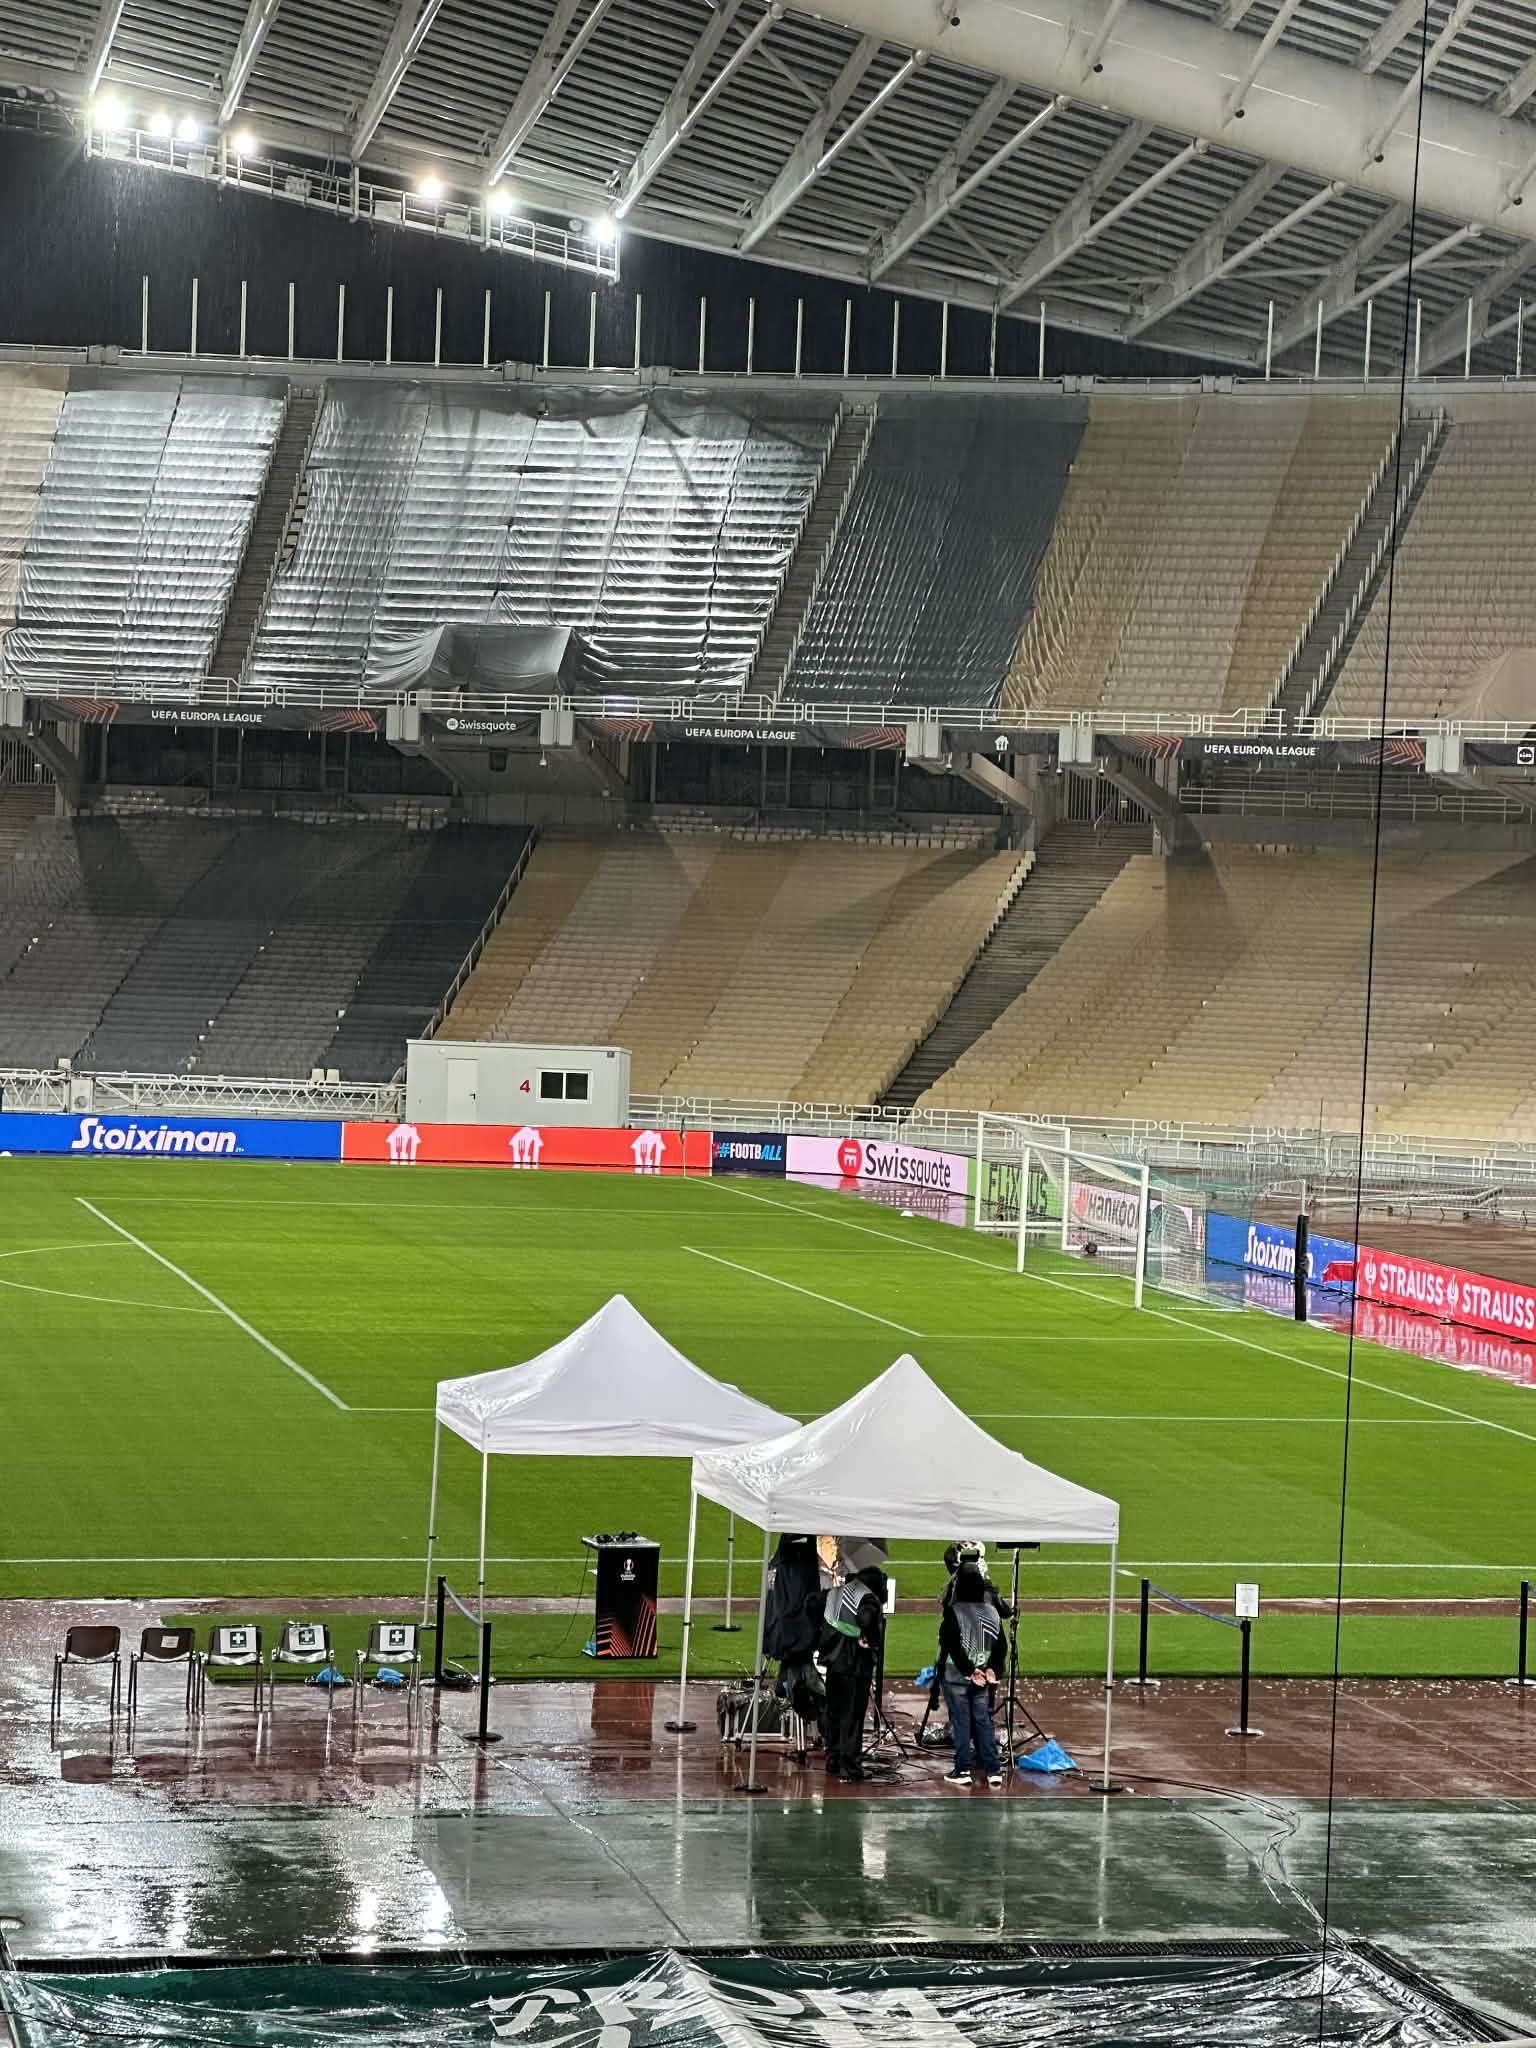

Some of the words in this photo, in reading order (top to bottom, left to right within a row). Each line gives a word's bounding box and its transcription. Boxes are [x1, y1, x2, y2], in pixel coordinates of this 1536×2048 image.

[151, 710, 178, 720] UEFA
[180, 711, 220, 721] EUROPA
[223, 713, 263, 723] LEAGUE
[459, 719, 517, 733] Swissquote
[685, 727, 712, 737] UEFA
[714, 728, 754, 739] EUROPA
[756, 730, 797, 740] LEAGUE
[1204, 744, 1231, 754] UEFA
[1233, 745, 1274, 756] EUROPA
[1276, 746, 1317, 756] LEAGUE
[519, 1079, 531, 1093] 4
[71, 1117, 237, 1153] Stoiximan
[718, 1142, 782, 1161] #FOOTBALL
[864, 1143, 951, 1188] Swissquote
[988, 1162, 1049, 1217] FLIXUS
[1088, 1192, 1141, 1230] Hankoo
[1244, 1225, 1314, 1278] Stoiximn
[1379, 1262, 1445, 1306] STRAUSS
[1461, 1282, 1536, 1330] STRAUSS
